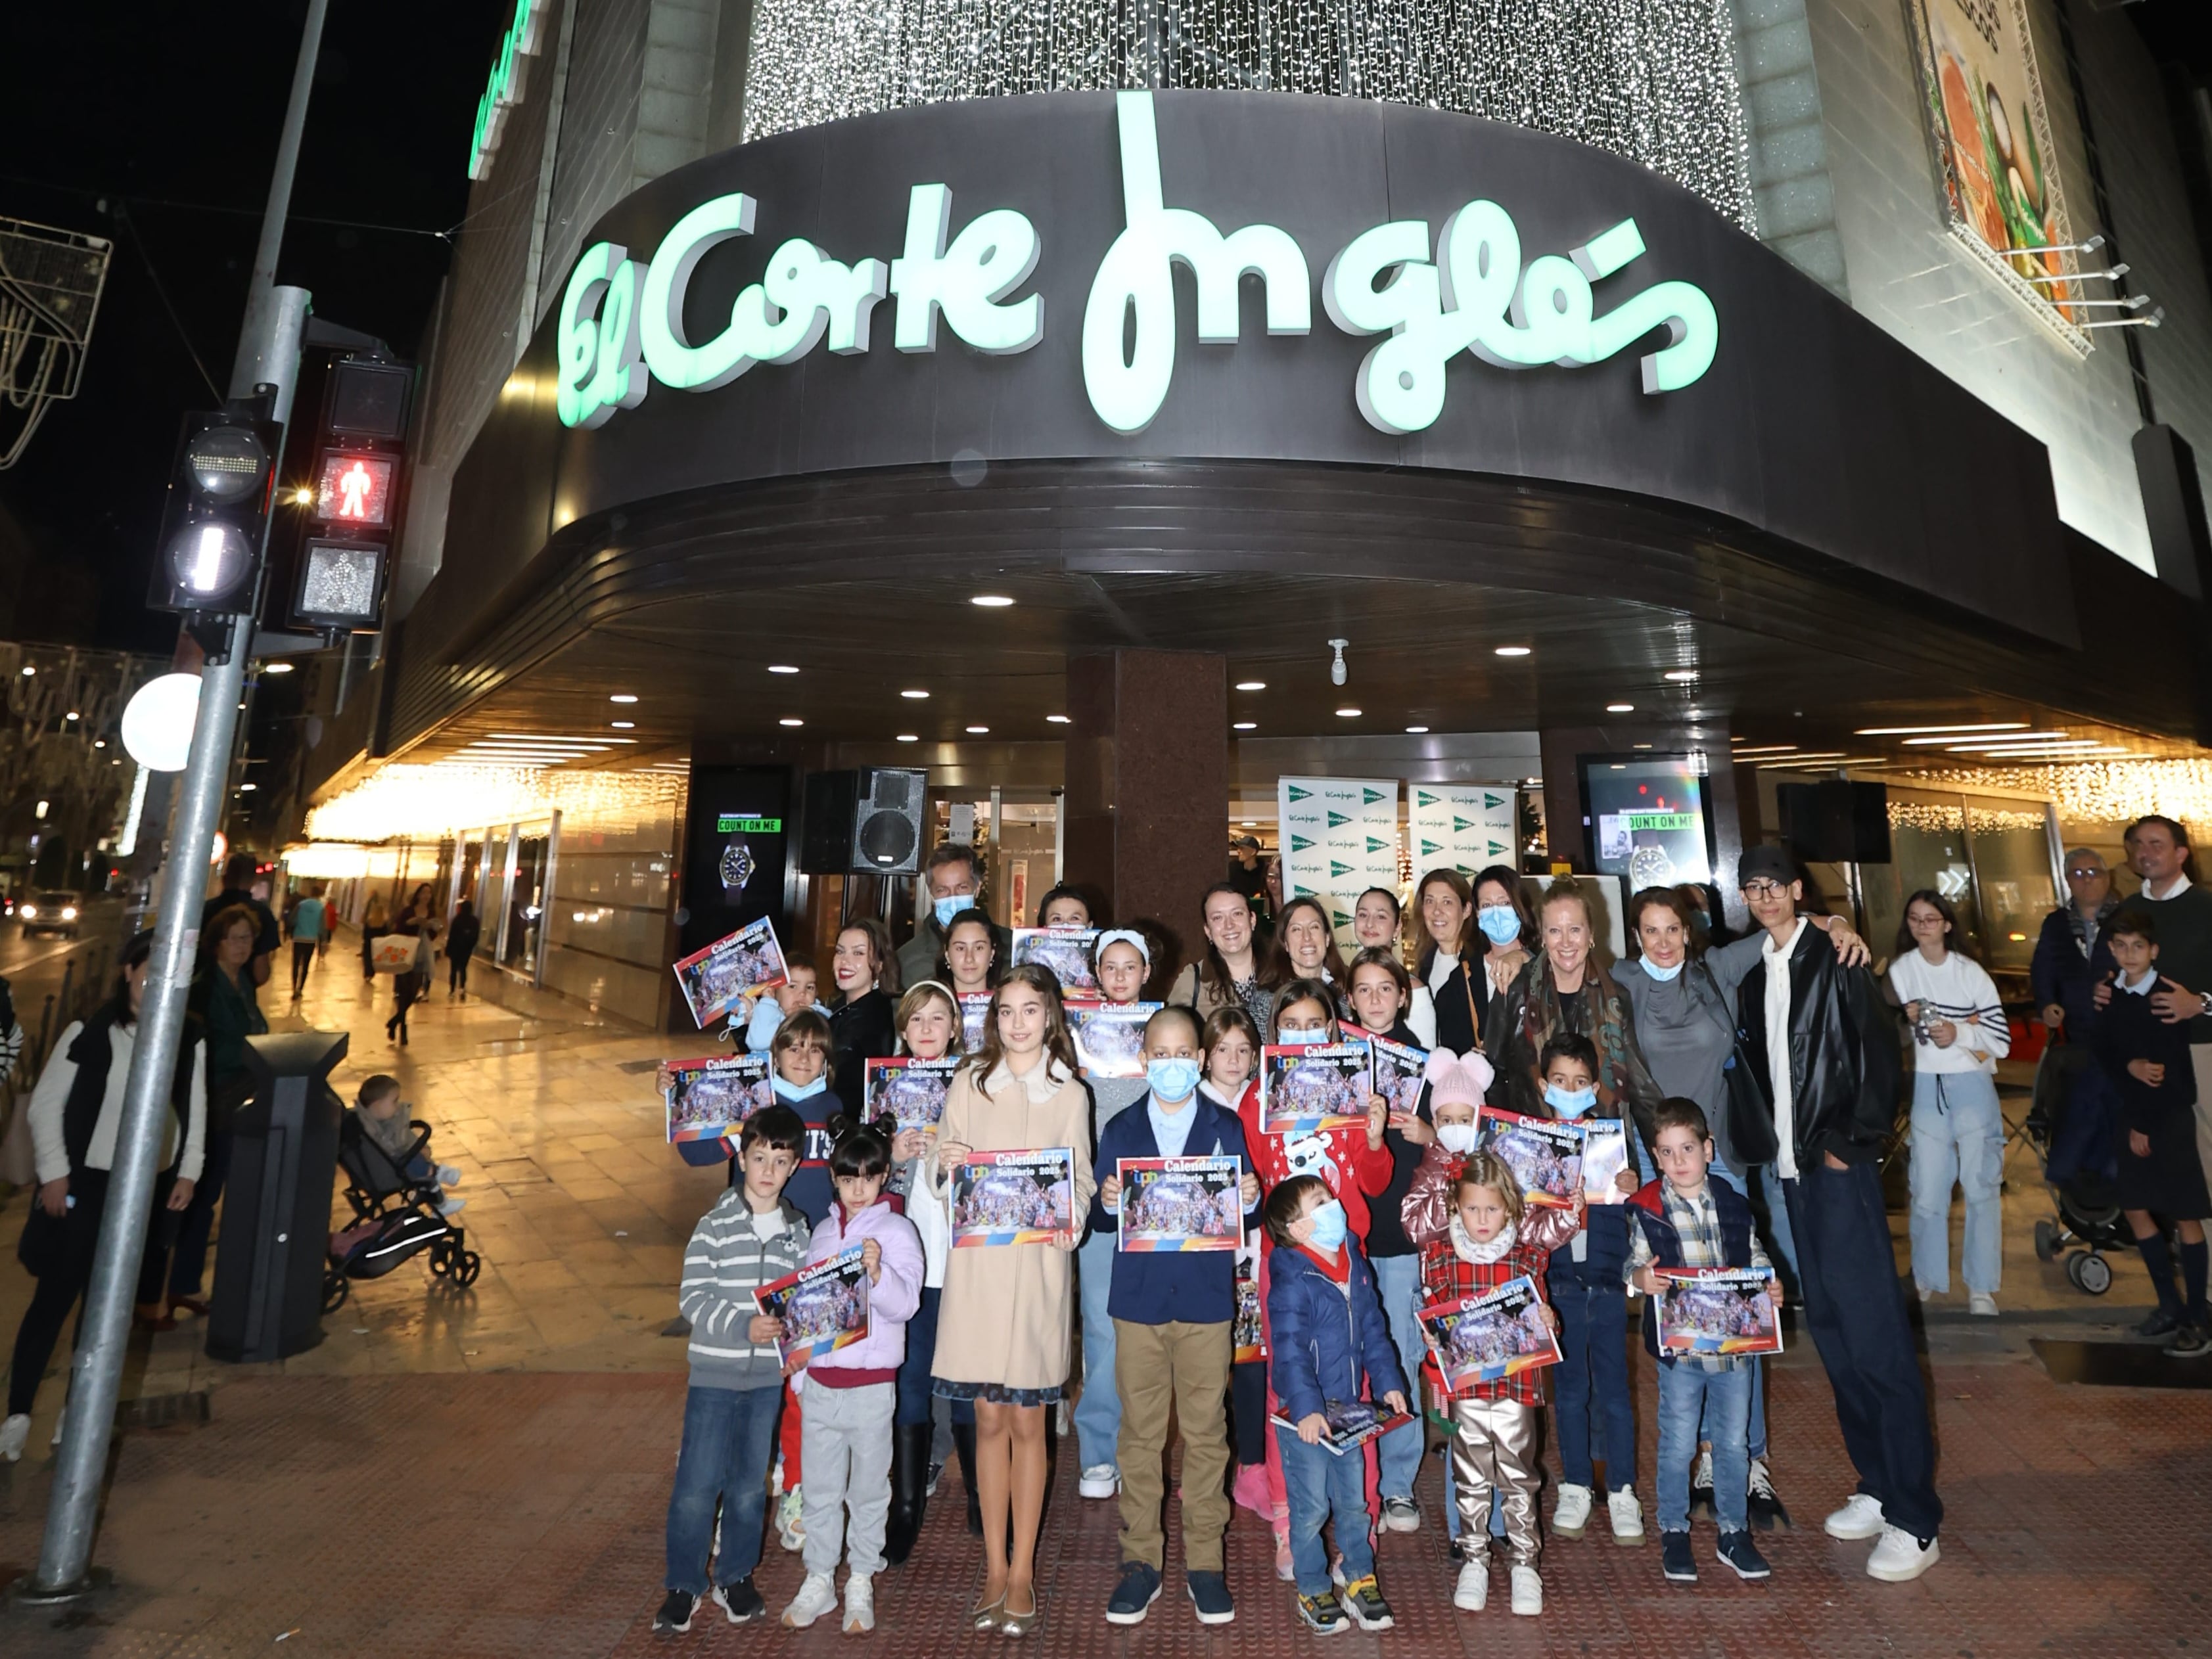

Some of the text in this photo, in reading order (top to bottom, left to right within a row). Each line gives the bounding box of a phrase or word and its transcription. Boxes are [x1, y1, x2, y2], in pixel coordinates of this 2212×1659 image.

[557, 89, 1719, 434] El Corte Inglés
[720, 821, 775, 830] COUNT ON ME
[1620, 816, 1656, 828] COUNT
[1661, 816, 1675, 827] ON
[1679, 815, 1694, 827] ME
[711, 923, 764, 955] Calendario
[714, 943, 745, 961] Solidario
[1099, 1001, 1156, 1014] Calendario
[1304, 1045, 1364, 1058] Calendario
[705, 1057, 764, 1071] Calendario
[1305, 1058, 1362, 1068] Solidario 2025
[706, 1070, 741, 1080] Solidario
[908, 1070, 942, 1079] Solidario
[1518, 1116, 1579, 1140] Calendario
[1518, 1129, 1575, 1149] Solidario 2025
[996, 1152, 1063, 1167] Calendario
[1164, 1159, 1231, 1173] Calendario
[996, 1166, 1061, 1177] Solidario 2025
[1165, 1173, 1228, 1183] Solidario 2025
[797, 1248, 863, 1283] Calendario
[802, 1271, 840, 1291] Solidario
[1697, 1268, 1765, 1281] Calendario
[1700, 1281, 1739, 1292] Solidario
[1460, 1283, 1524, 1312] Calendario
[1465, 1294, 1525, 1321] Solidario 2025
